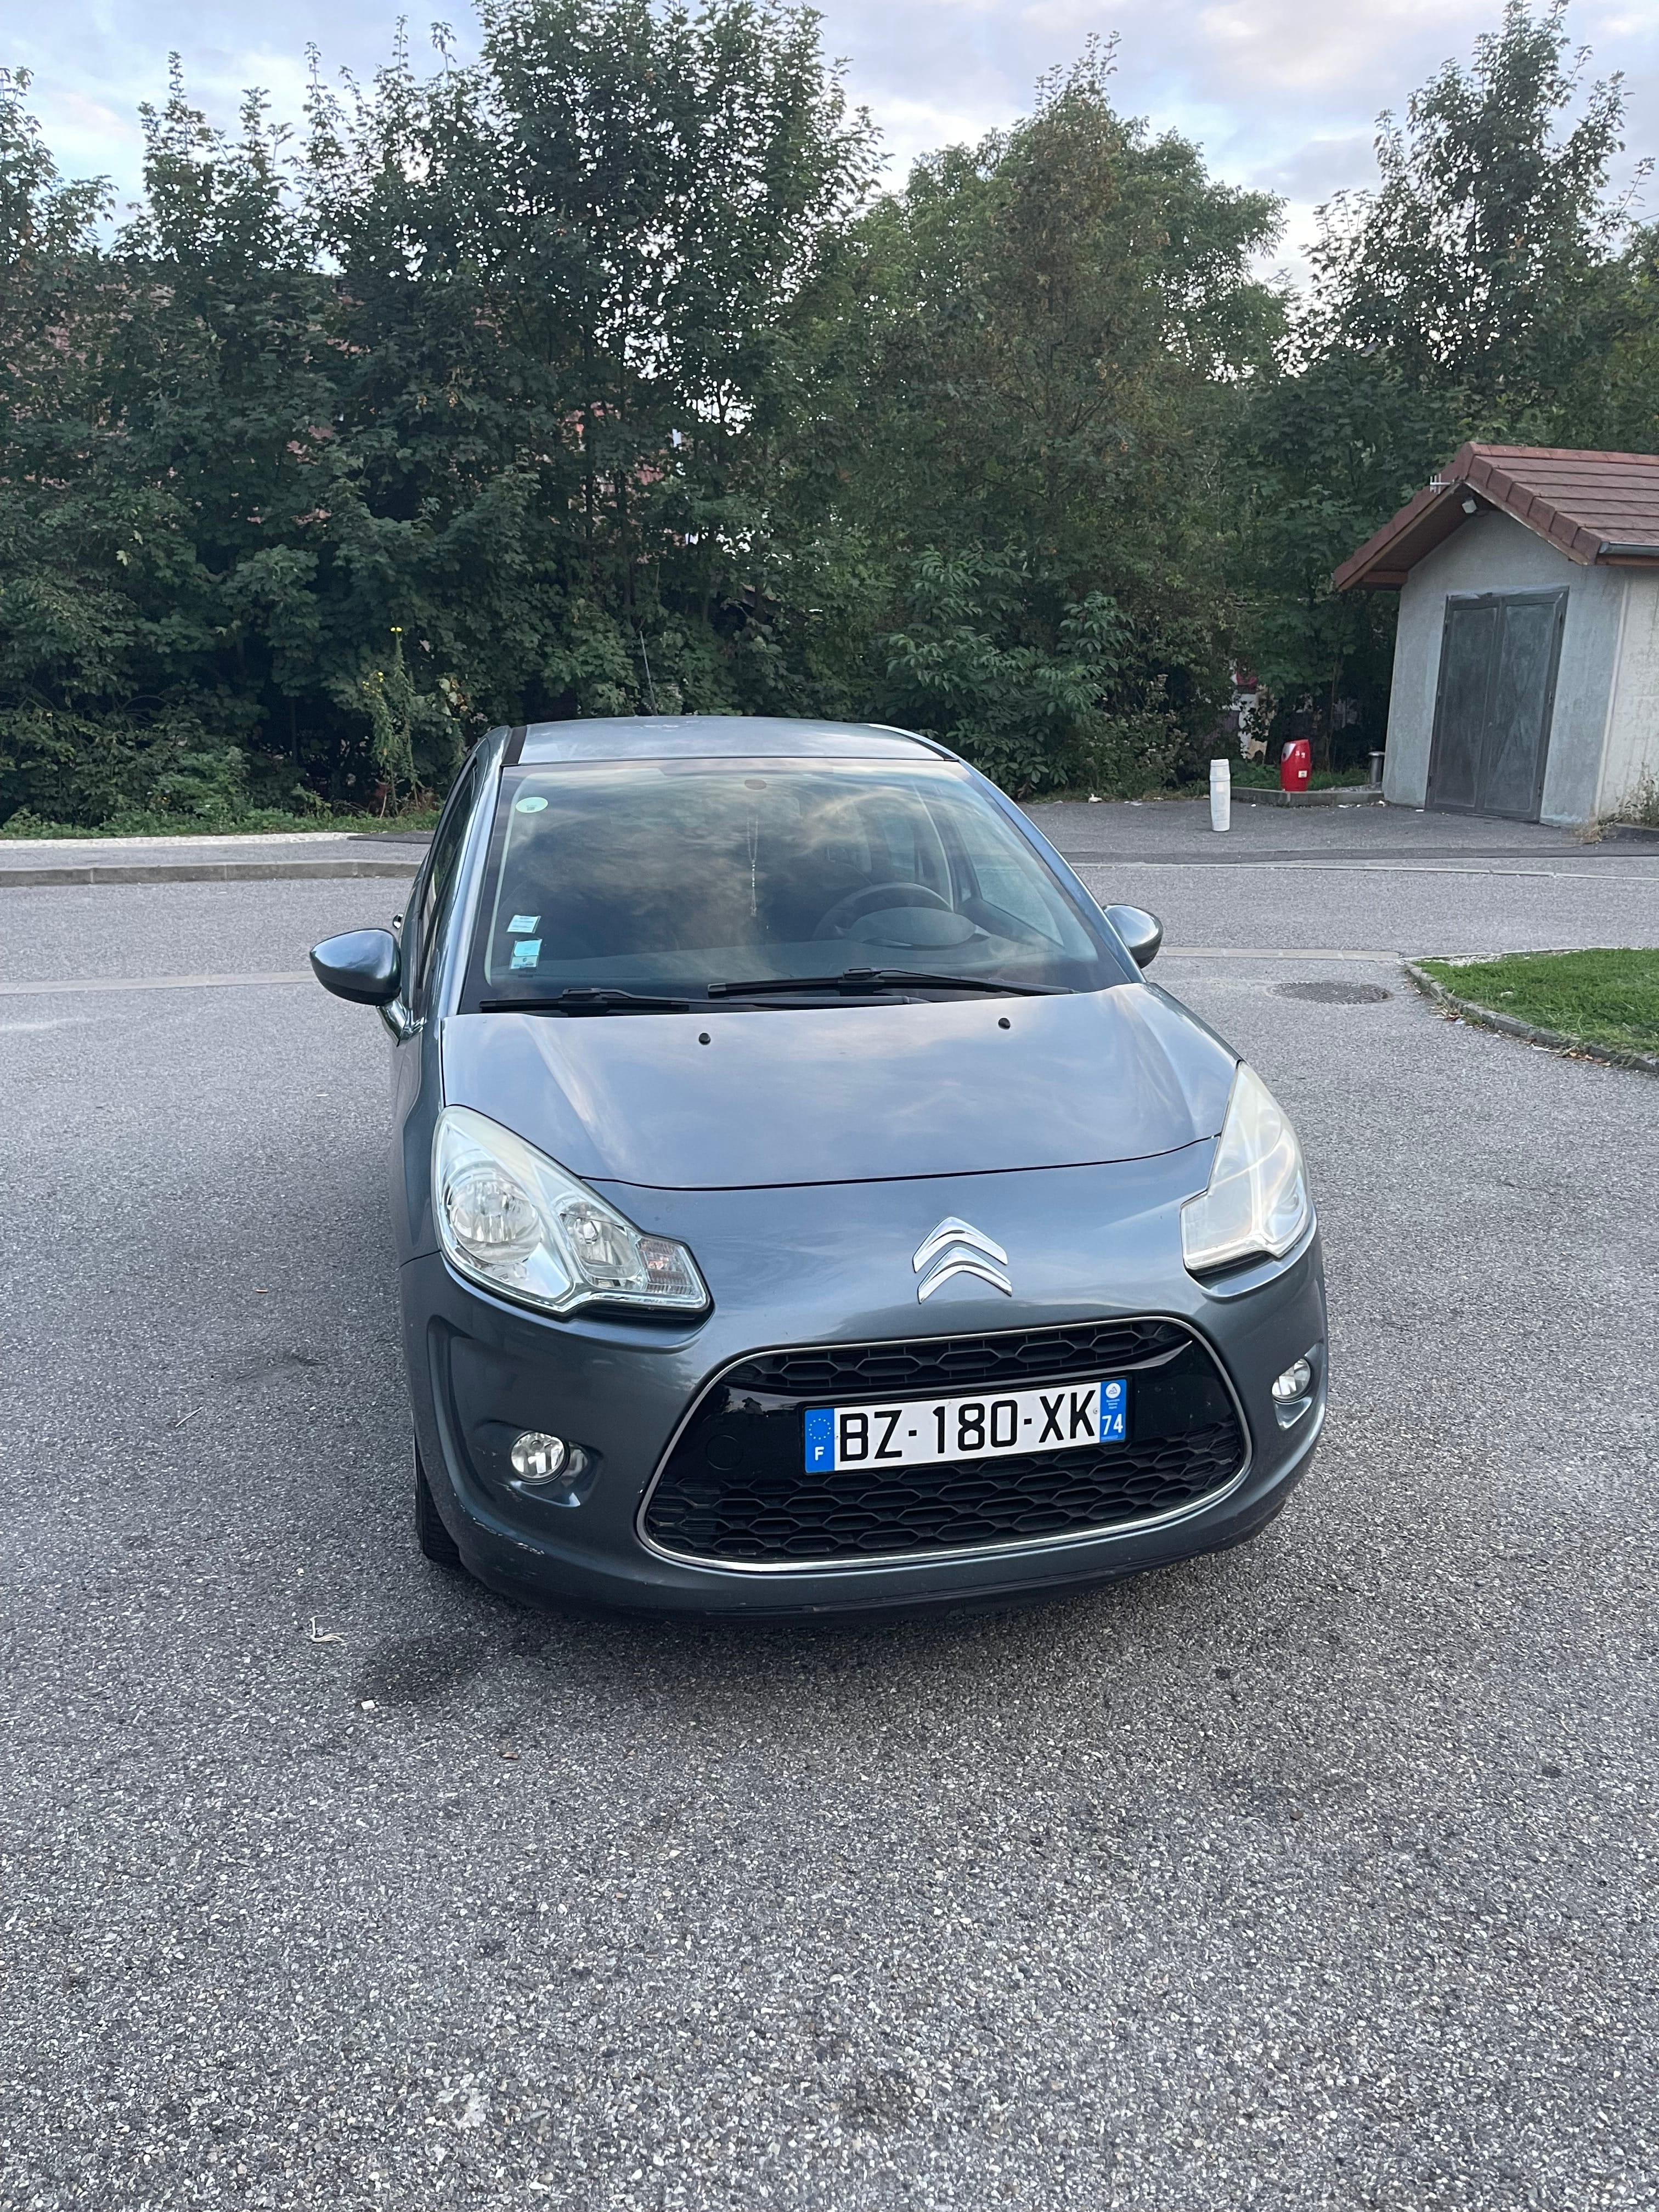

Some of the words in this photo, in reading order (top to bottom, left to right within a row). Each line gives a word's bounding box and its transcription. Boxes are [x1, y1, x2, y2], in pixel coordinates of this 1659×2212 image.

[840, 1390, 1096, 1462] BZ-180-XK
[1102, 1413, 1124, 1435] 74
[815, 1446, 824, 1461] F
